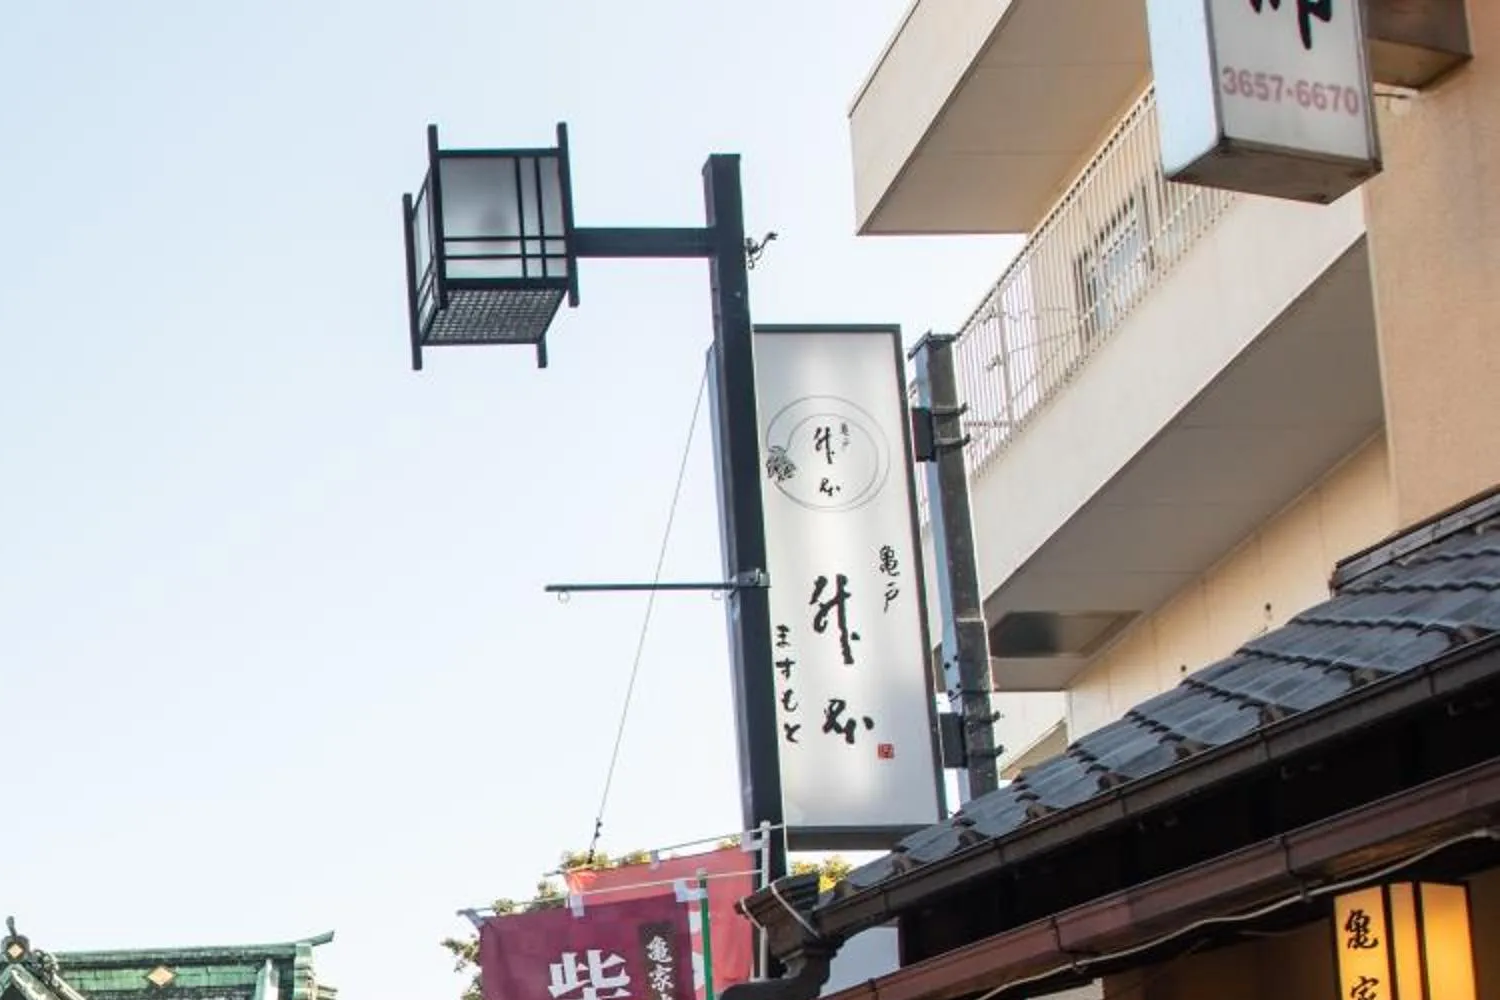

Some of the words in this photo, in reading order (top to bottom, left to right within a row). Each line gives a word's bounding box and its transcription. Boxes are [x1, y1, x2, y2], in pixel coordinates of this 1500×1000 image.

[879, 545, 901, 613] 亀戸
[775, 624, 801, 743] ますもと
